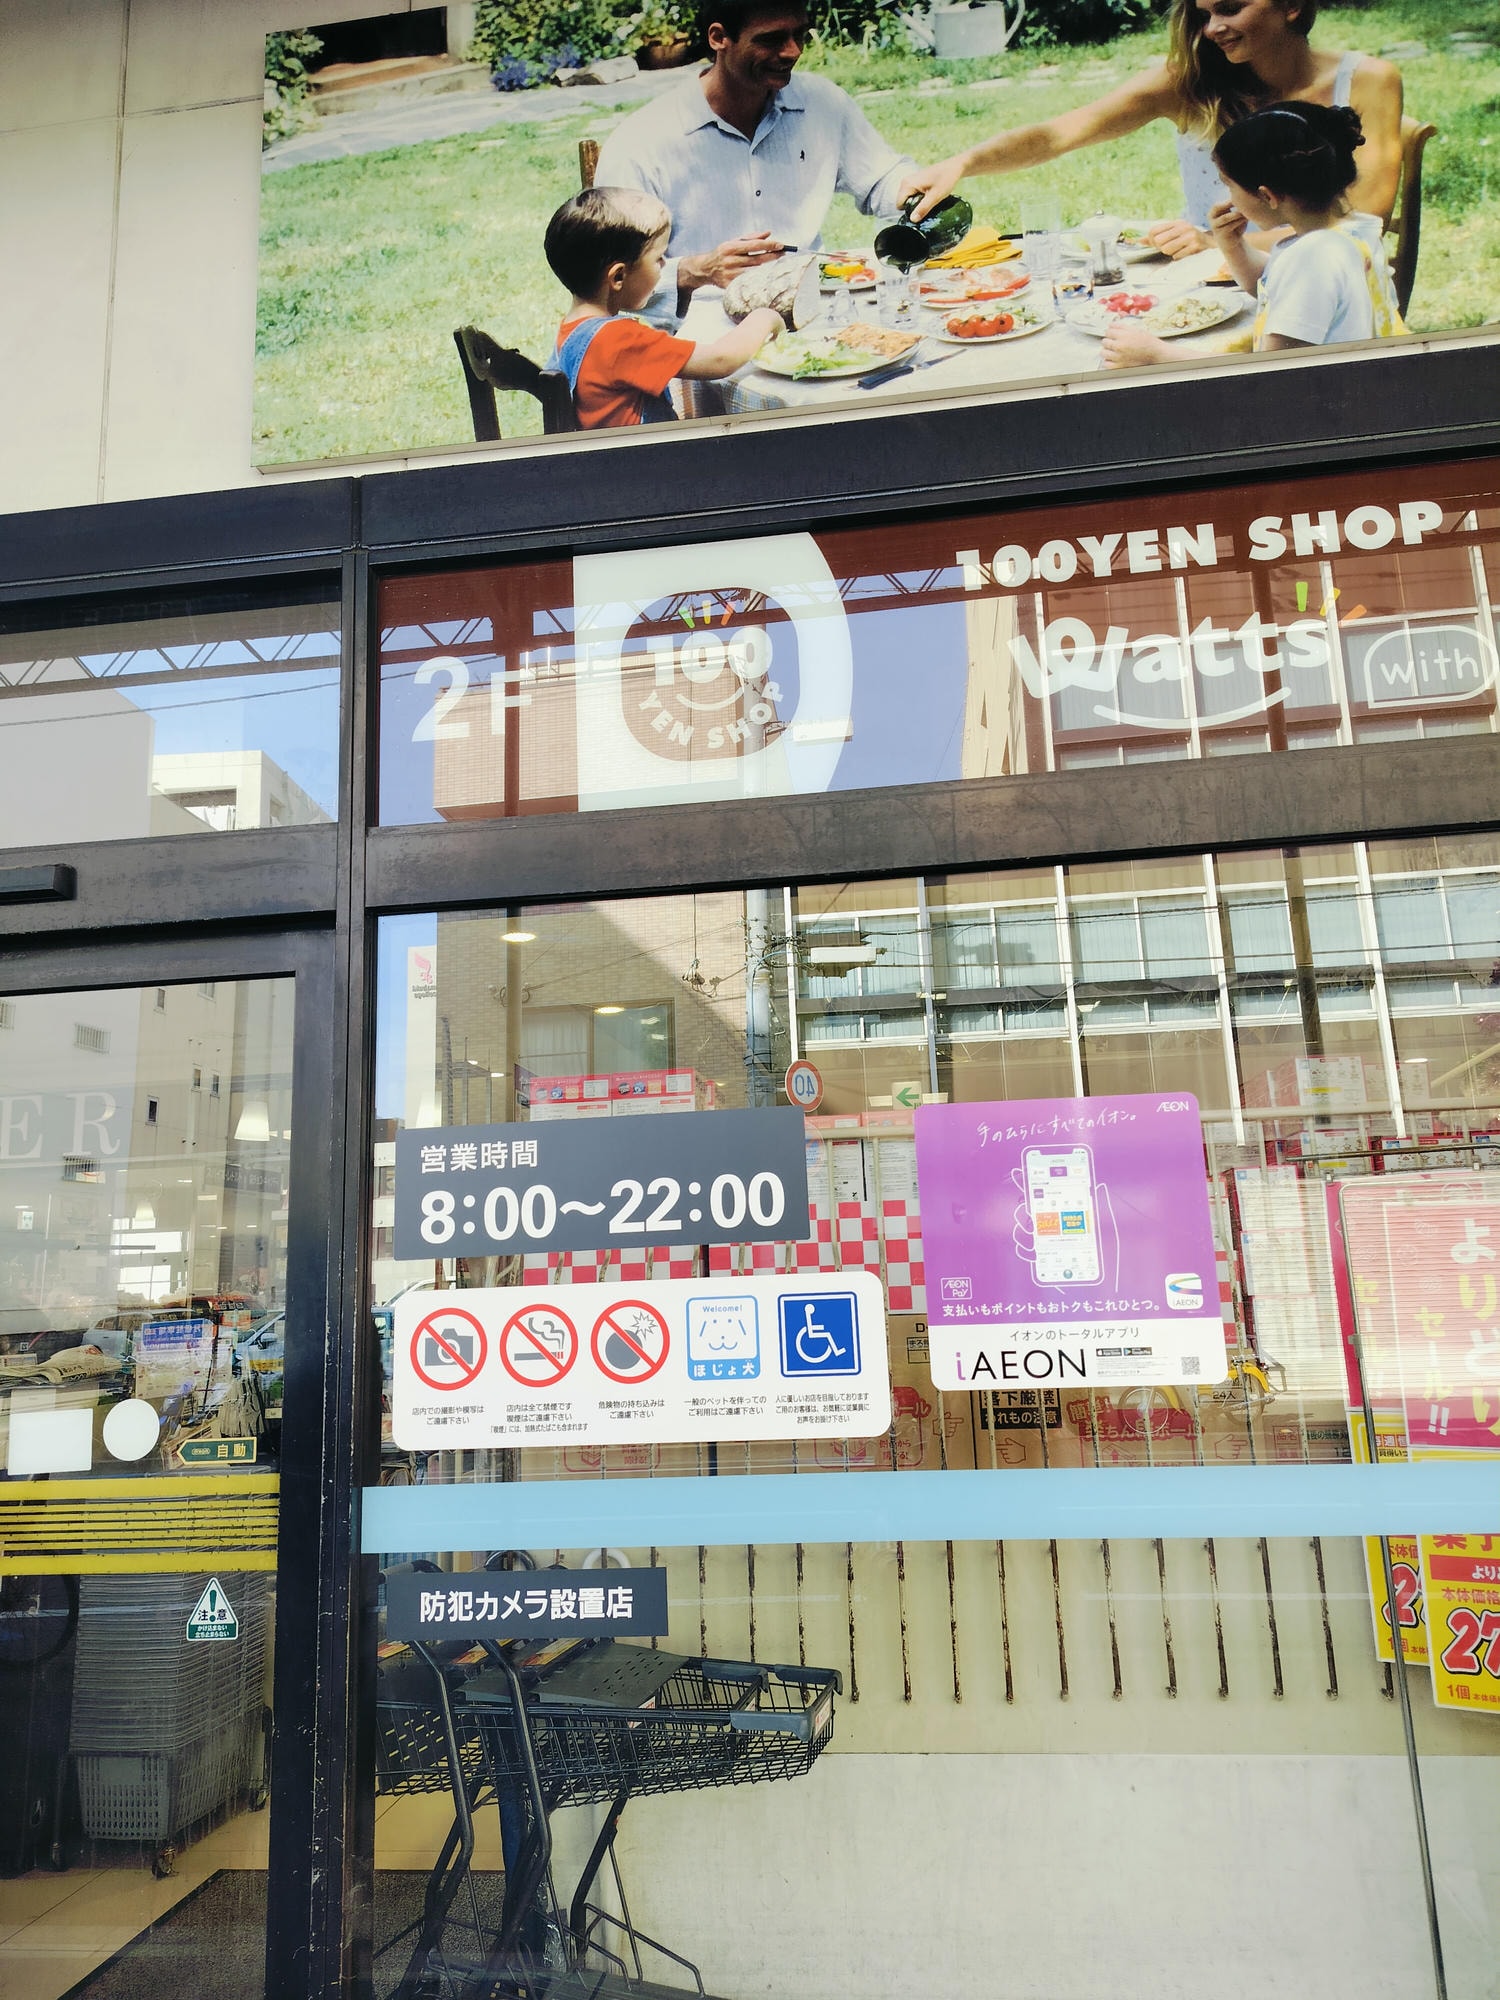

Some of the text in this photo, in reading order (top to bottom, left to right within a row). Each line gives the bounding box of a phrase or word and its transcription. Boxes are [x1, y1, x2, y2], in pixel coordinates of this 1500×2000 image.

[955, 500, 1444, 592] 100YEN SHOP
[646, 626, 774, 688] 100
[1007, 611, 1332, 699] Watts
[1380, 647, 1481, 686] with
[412, 655, 532, 742] 2F
[637, 680, 785, 750] YEN SHOP
[419, 1140, 539, 1174] 営業時間
[702, 1304, 743, 1313] Welcome!
[1010, 1326, 1141, 1342] イオンのトータルアプリ
[693, 1361, 755, 1378] ほじょ犬
[956, 1348, 1087, 1381] iAEON
[506, 1402, 572, 1412] 店内は全て禁煙です
[598, 1399, 665, 1409] 危険物の持ち込みは
[684, 1395, 767, 1406] 一般のペットを伴っての
[506, 1413, 573, 1423] 喫煙はご遠慮下さい
[609, 1409, 654, 1419] ご遠慮下さい
[688, 1407, 764, 1417] ご利用はご遠慮下さい
[426, 1416, 470, 1426] ご遠慮下さい
[217, 1443, 247, 1458] 自動
[420, 1586, 634, 1623] 防犯カメラ設置店
